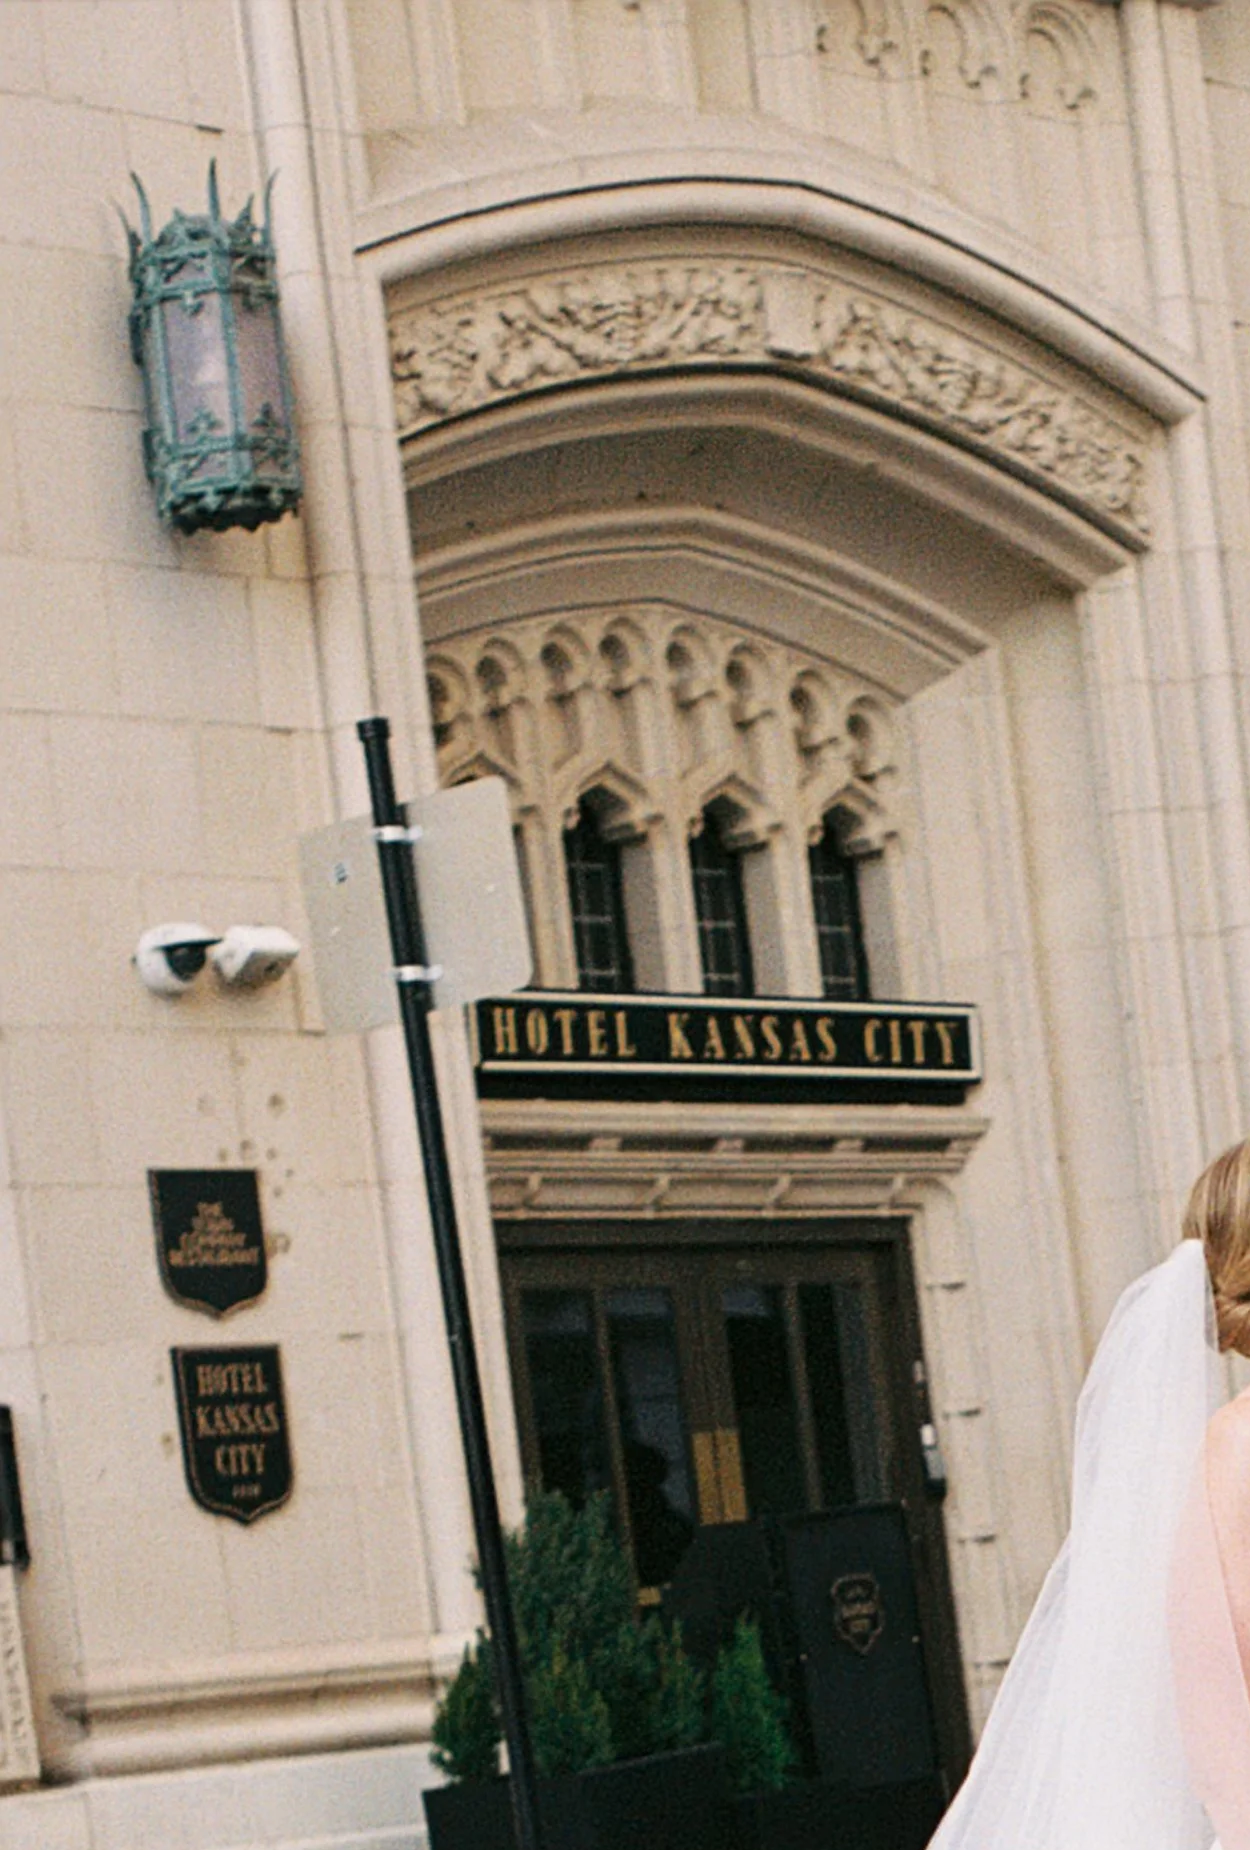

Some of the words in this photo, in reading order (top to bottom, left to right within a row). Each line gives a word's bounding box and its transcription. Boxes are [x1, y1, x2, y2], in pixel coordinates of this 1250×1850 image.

[492, 1006, 637, 1057] HOTEL
[667, 1011, 839, 1062] KANSAS
[863, 1017, 961, 1065] CITY
[196, 1361, 268, 1397] HOTEL
[196, 1402, 280, 1439] KANSAS
[215, 1443, 266, 1477] CITY
